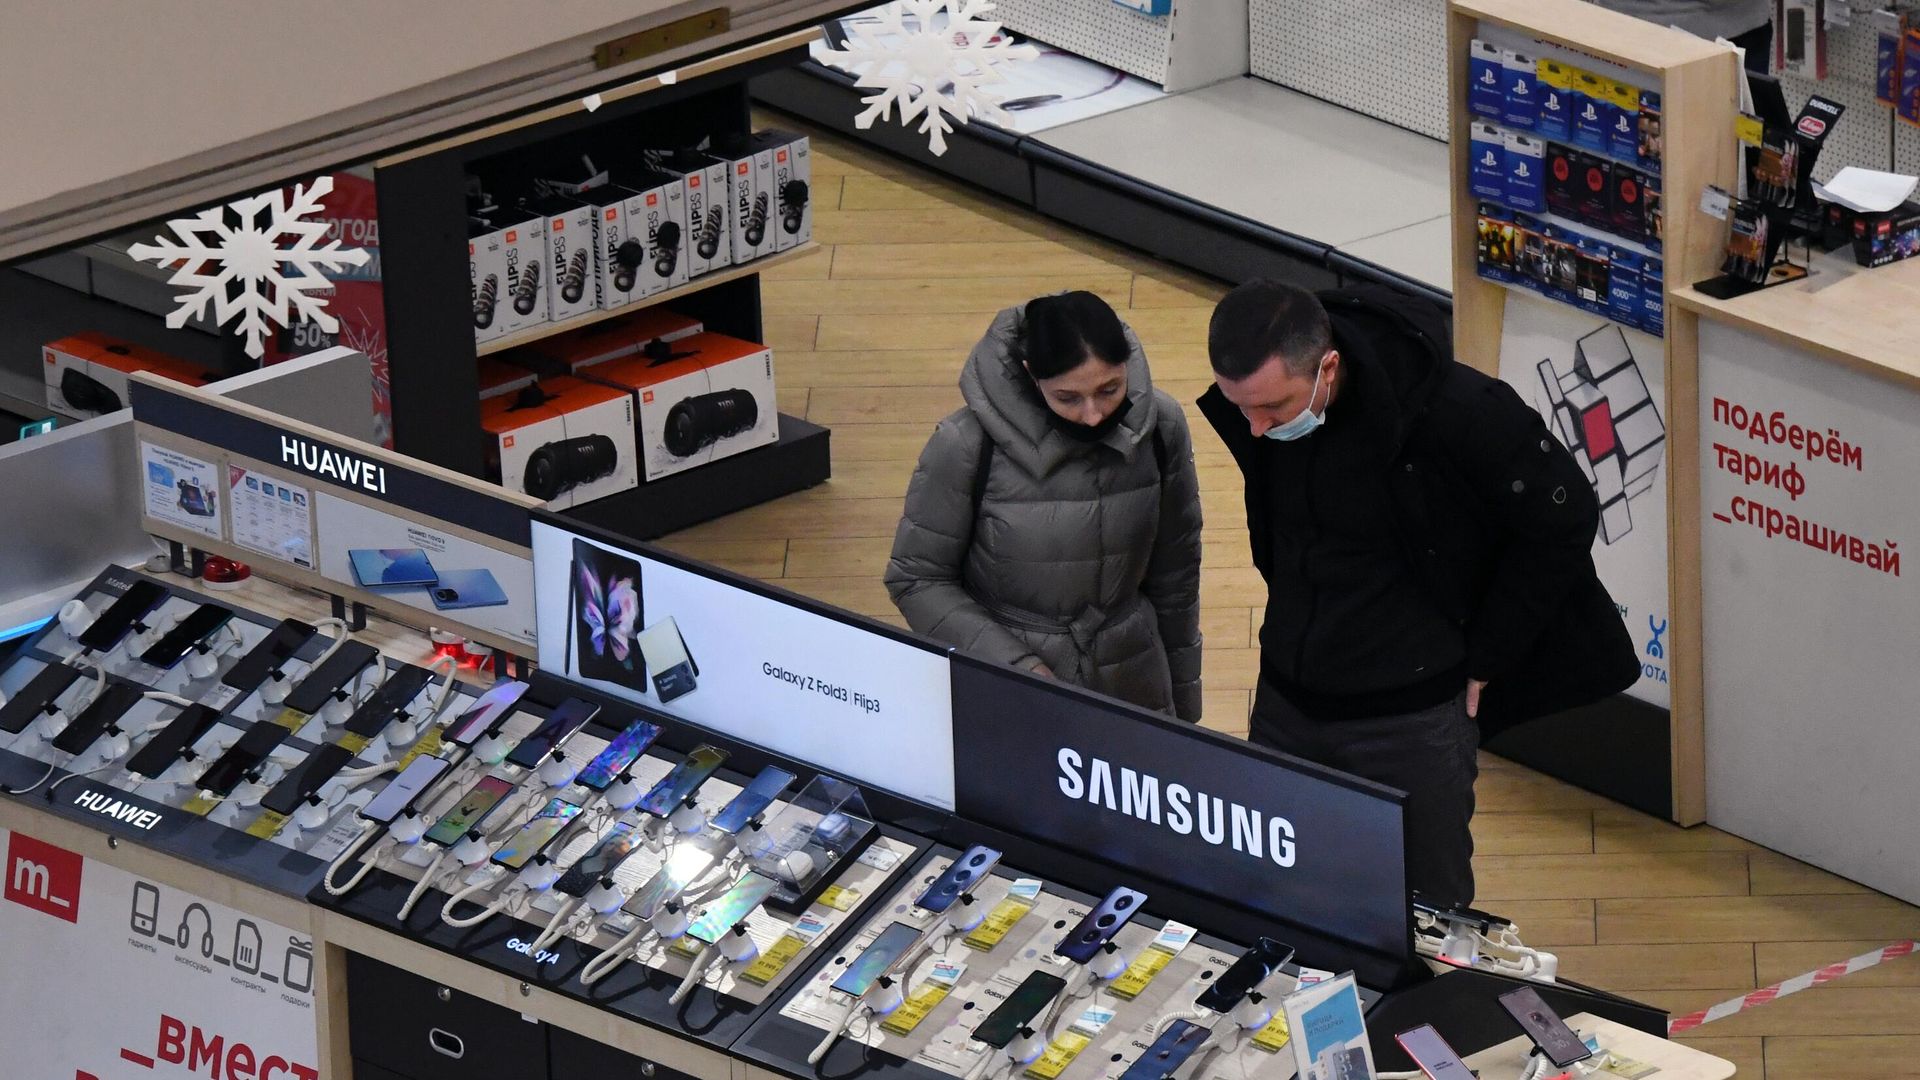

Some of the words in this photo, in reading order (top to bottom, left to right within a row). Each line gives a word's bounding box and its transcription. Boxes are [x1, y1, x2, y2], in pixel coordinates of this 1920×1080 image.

[1713, 397, 1863, 471] подберём
[281, 435, 386, 494] HUAWEI
[1713, 442, 1806, 501] тариф
[762, 662, 806, 690] Galaxy
[807, 676, 815, 691] Z
[816, 679, 848, 702] Fold3
[853, 692, 880, 714] Flip3
[73, 789, 163, 830] HUAWEI
[1057, 747, 1296, 868] SAMSUNG
[128, 938, 157, 954] гаджеты
[174, 954, 213, 974] аксессуары
[546, 953, 560, 965] A
[230, 976, 267, 994] контракты
[280, 993, 311, 1009] подарки
